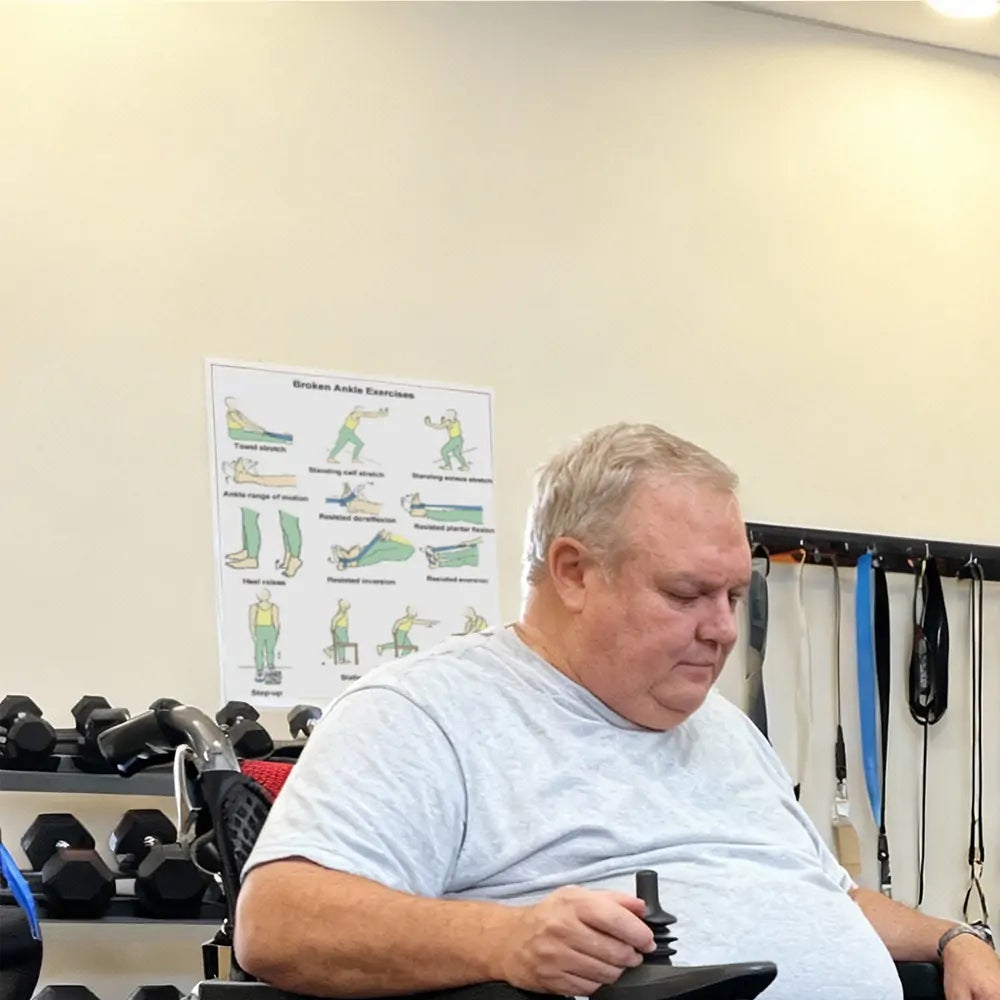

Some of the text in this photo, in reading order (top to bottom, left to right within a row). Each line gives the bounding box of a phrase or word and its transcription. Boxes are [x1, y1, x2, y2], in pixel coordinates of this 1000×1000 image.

[293, 380, 415, 399] Broken Ankle Exercises
[223, 490, 246, 498] Ankle
[247, 492, 270, 501] range
